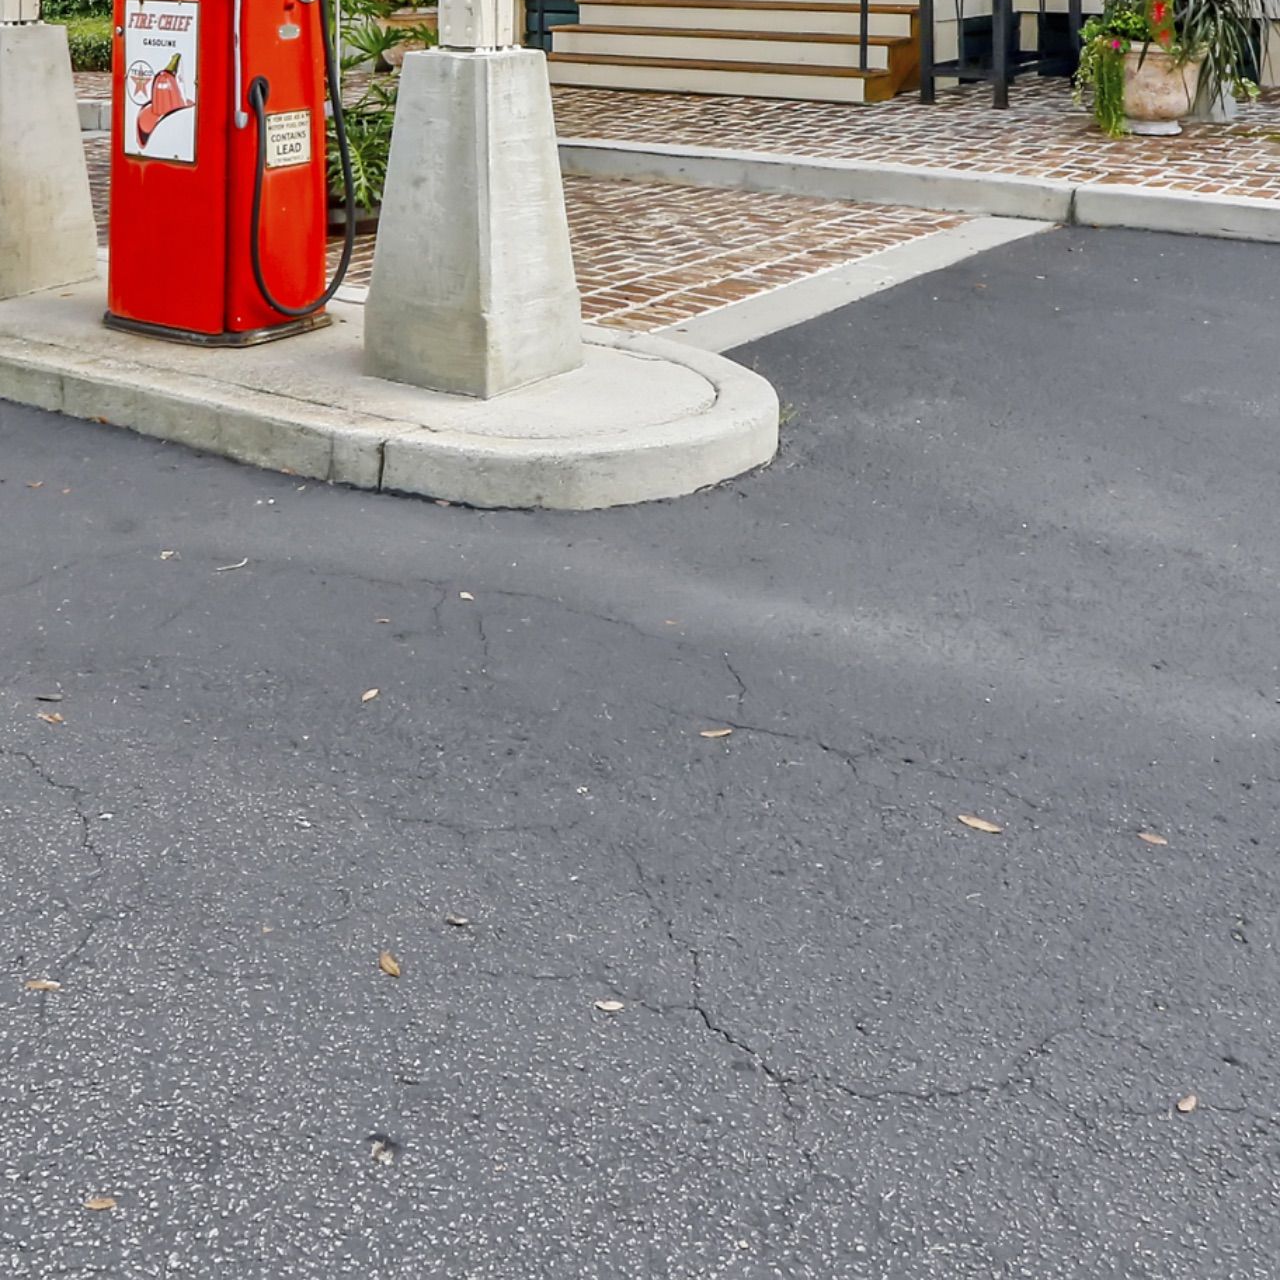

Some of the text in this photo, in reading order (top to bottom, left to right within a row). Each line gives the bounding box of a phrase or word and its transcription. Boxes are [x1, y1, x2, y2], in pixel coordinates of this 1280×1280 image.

[128, 12, 193, 31] FIRE-CHIEF
[143, 38, 177, 47] GASOLINE
[271, 130, 306, 142] CONTAINS
[277, 142, 302, 155] LEAD
